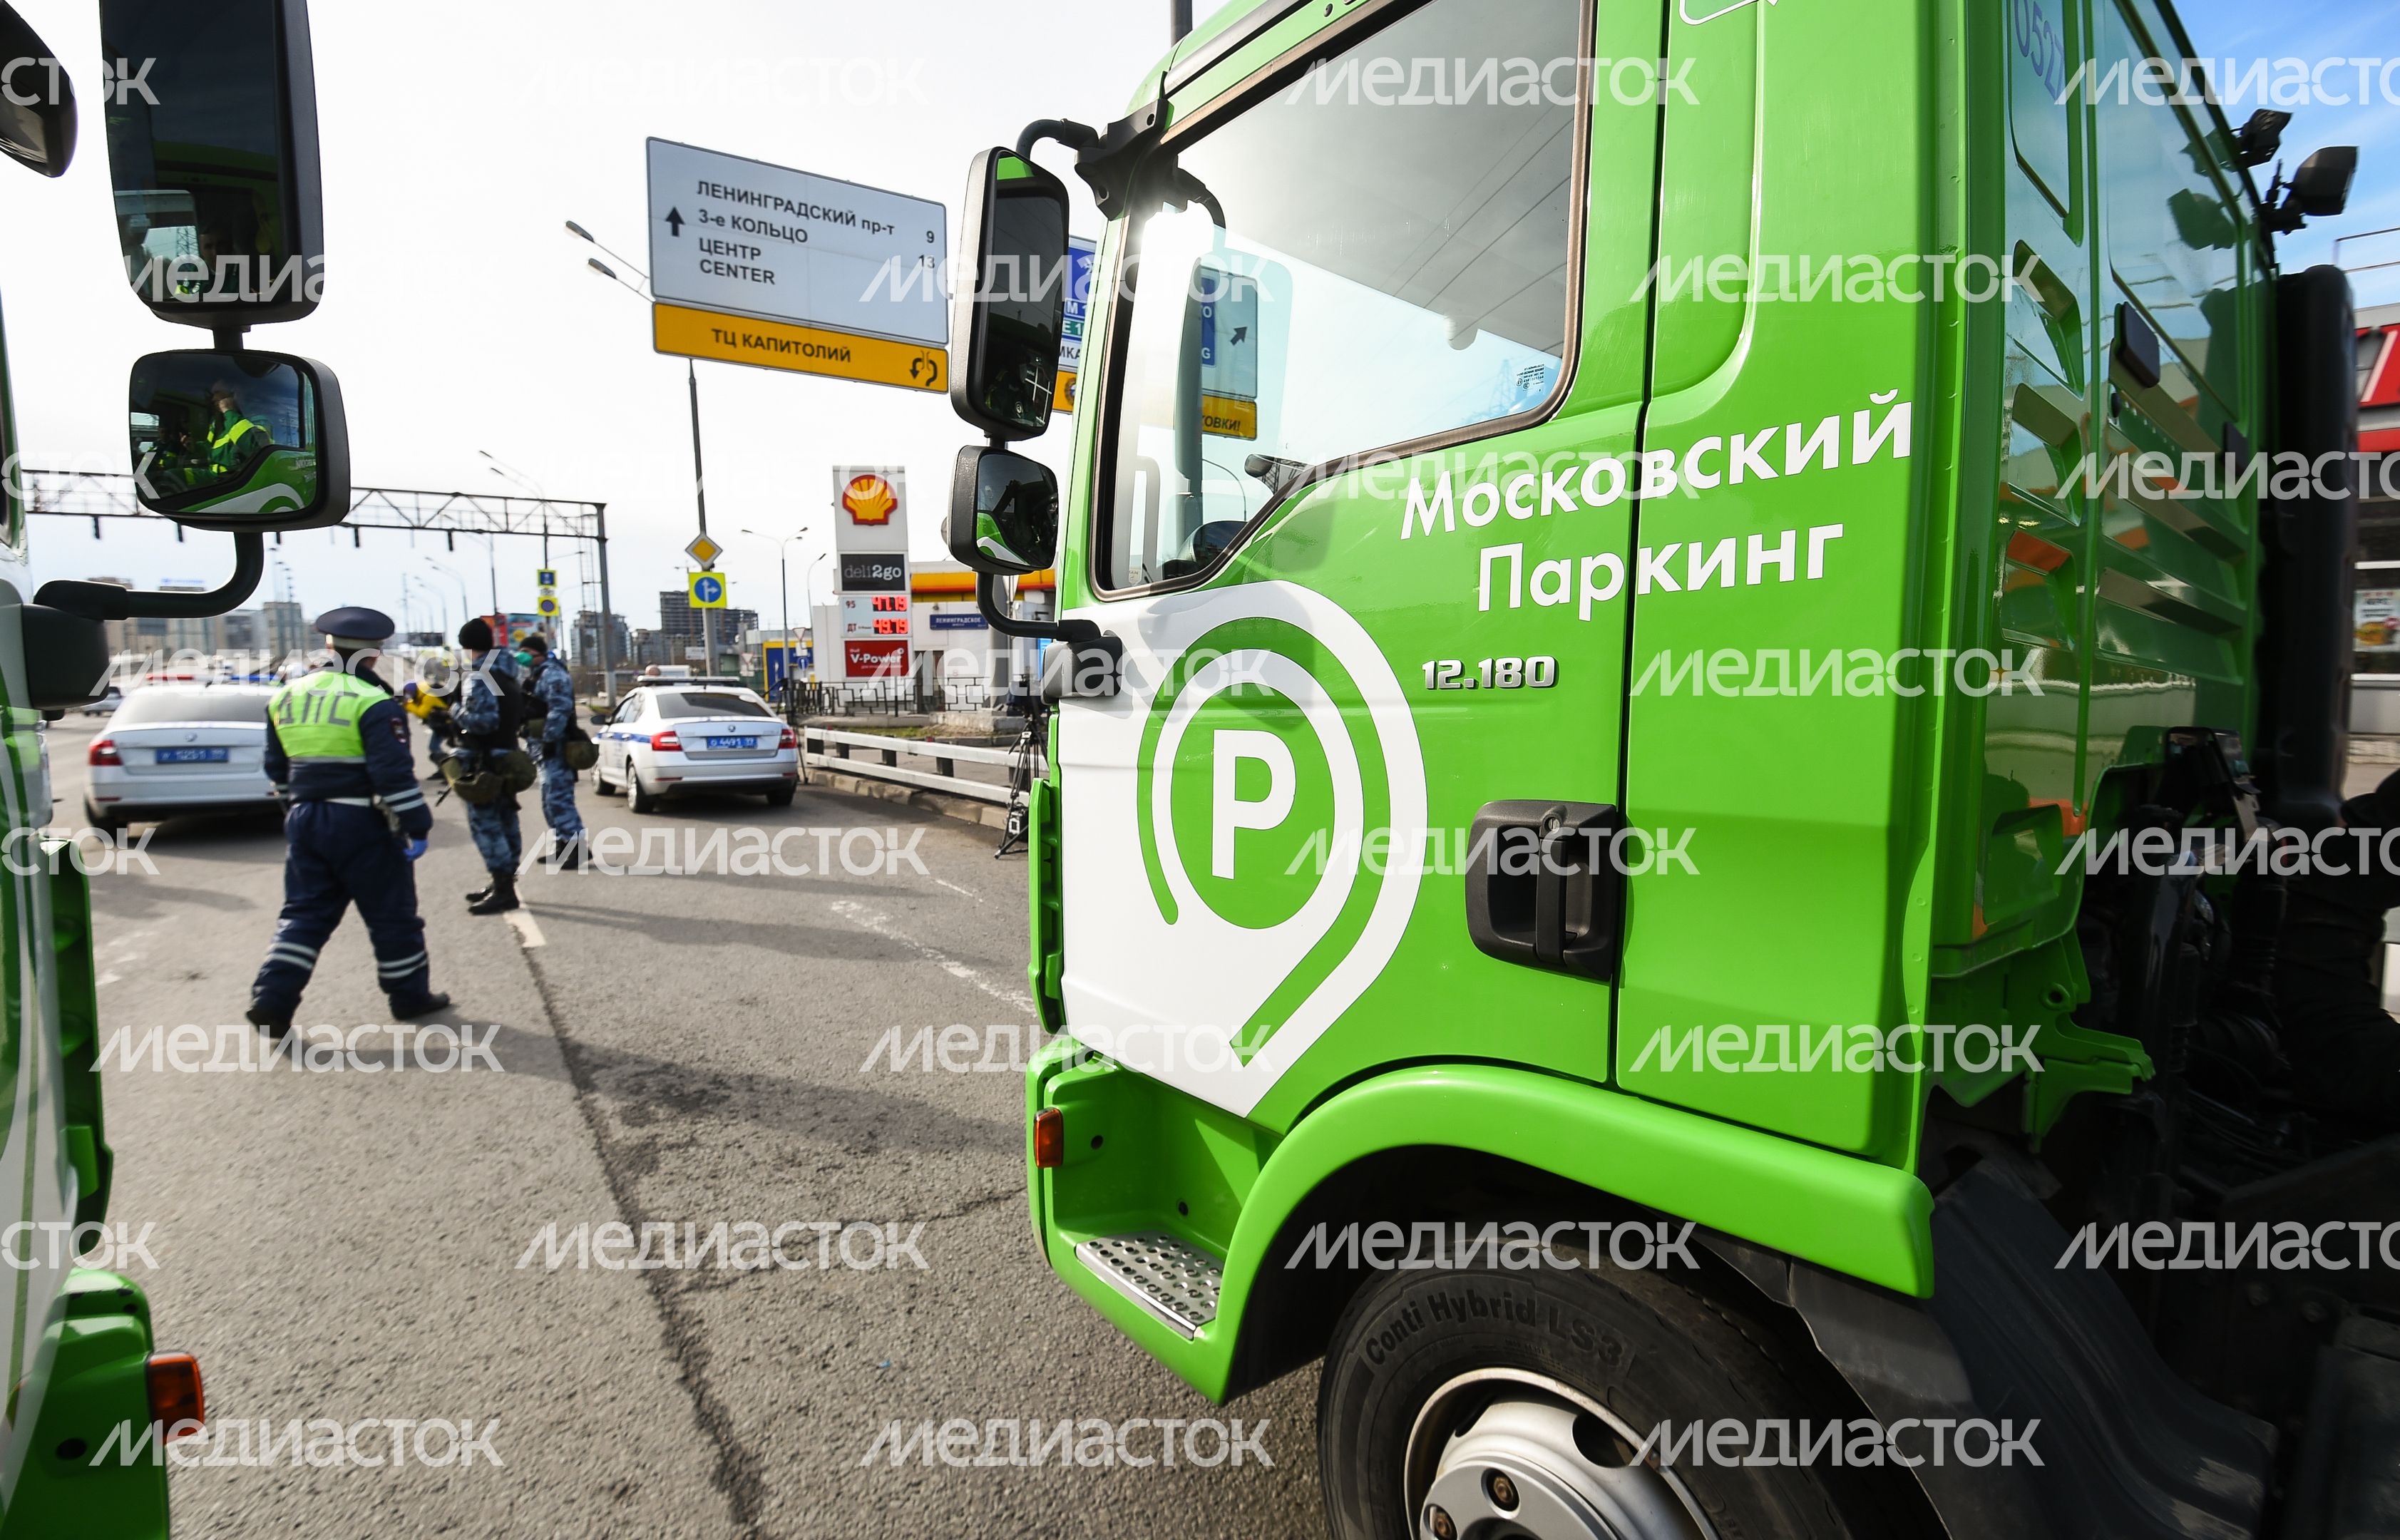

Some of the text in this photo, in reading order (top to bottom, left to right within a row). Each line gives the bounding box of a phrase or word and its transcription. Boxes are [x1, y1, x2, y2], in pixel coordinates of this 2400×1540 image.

[697, 181, 935, 244] ЛЕНИНГРАДСКИЙ пр-т 9
[699, 209, 935, 270] 3-е КОЛЬЦО 13
[699, 237, 761, 260] ЦЕНТР
[699, 260, 776, 284] CENTER
[712, 329, 851, 363] ТЦ КАПИТОЛИЙ
[1400, 389, 1912, 540] Московский
[844, 565, 902, 580] deli2go
[1477, 523, 1844, 622] Паркинг
[1422, 655, 1558, 691] 12.180
[1365, 1290, 1626, 1368] Conti Hybrid LS3
